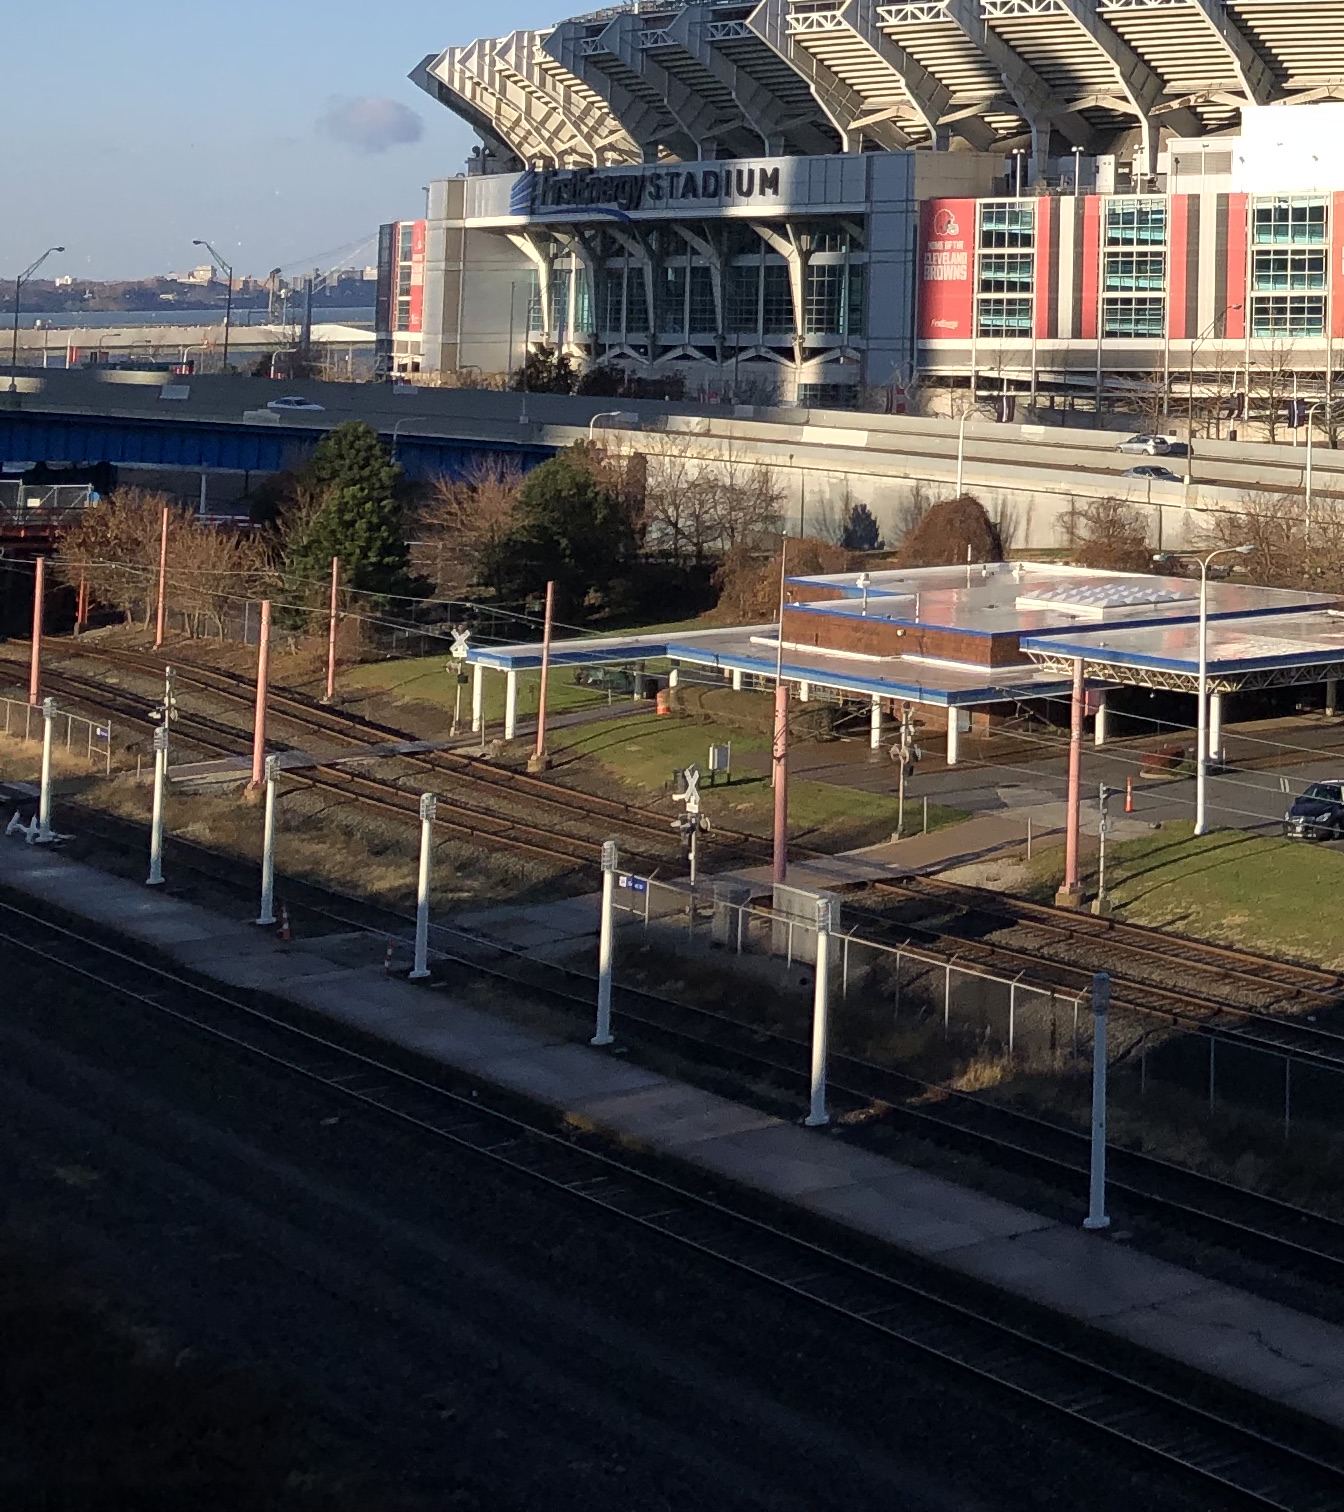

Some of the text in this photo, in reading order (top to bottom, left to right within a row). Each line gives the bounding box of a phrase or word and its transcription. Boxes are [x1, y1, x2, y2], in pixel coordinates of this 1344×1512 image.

[647, 166, 780, 201] STADIUM
[924, 251, 967, 264] CLEVELAND
[923, 264, 967, 281] BROWNS
